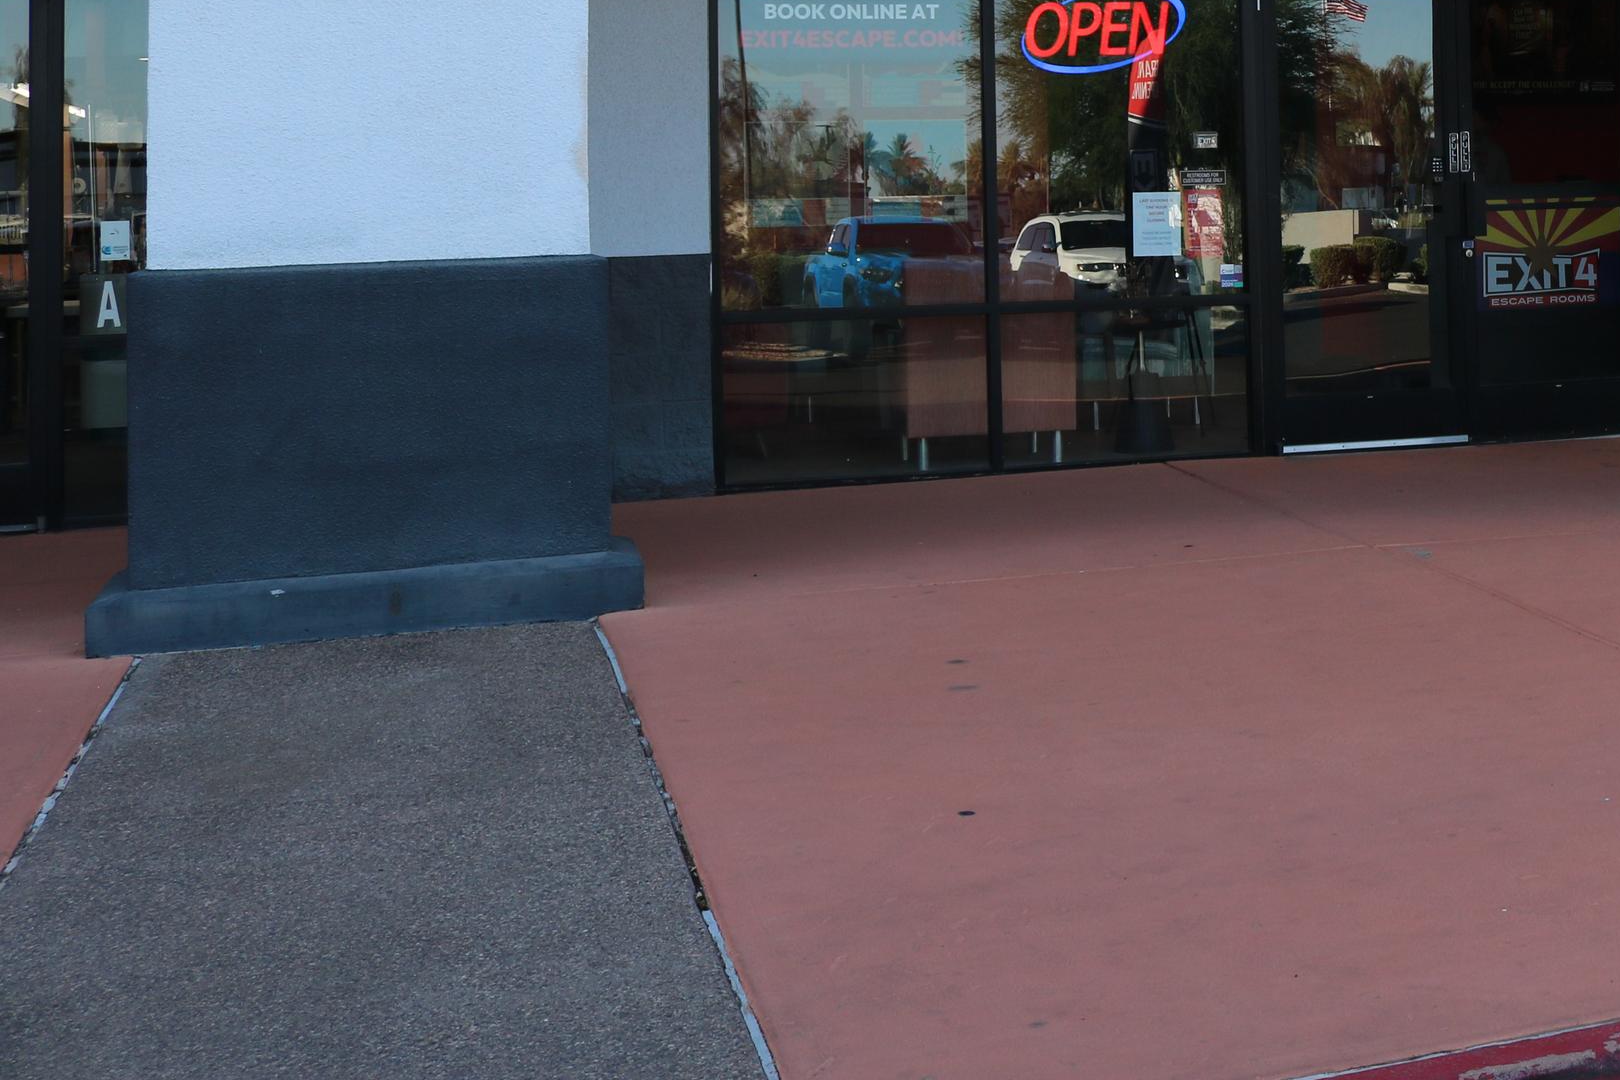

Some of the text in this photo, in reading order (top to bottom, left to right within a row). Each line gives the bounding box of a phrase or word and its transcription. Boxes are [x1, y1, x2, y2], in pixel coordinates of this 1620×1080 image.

[763, 3, 940, 21] BOOK ONLINE AT
[1026, 1, 1170, 58] OPEN
[1491, 294, 1596, 306] ESCAPE ROOMS
